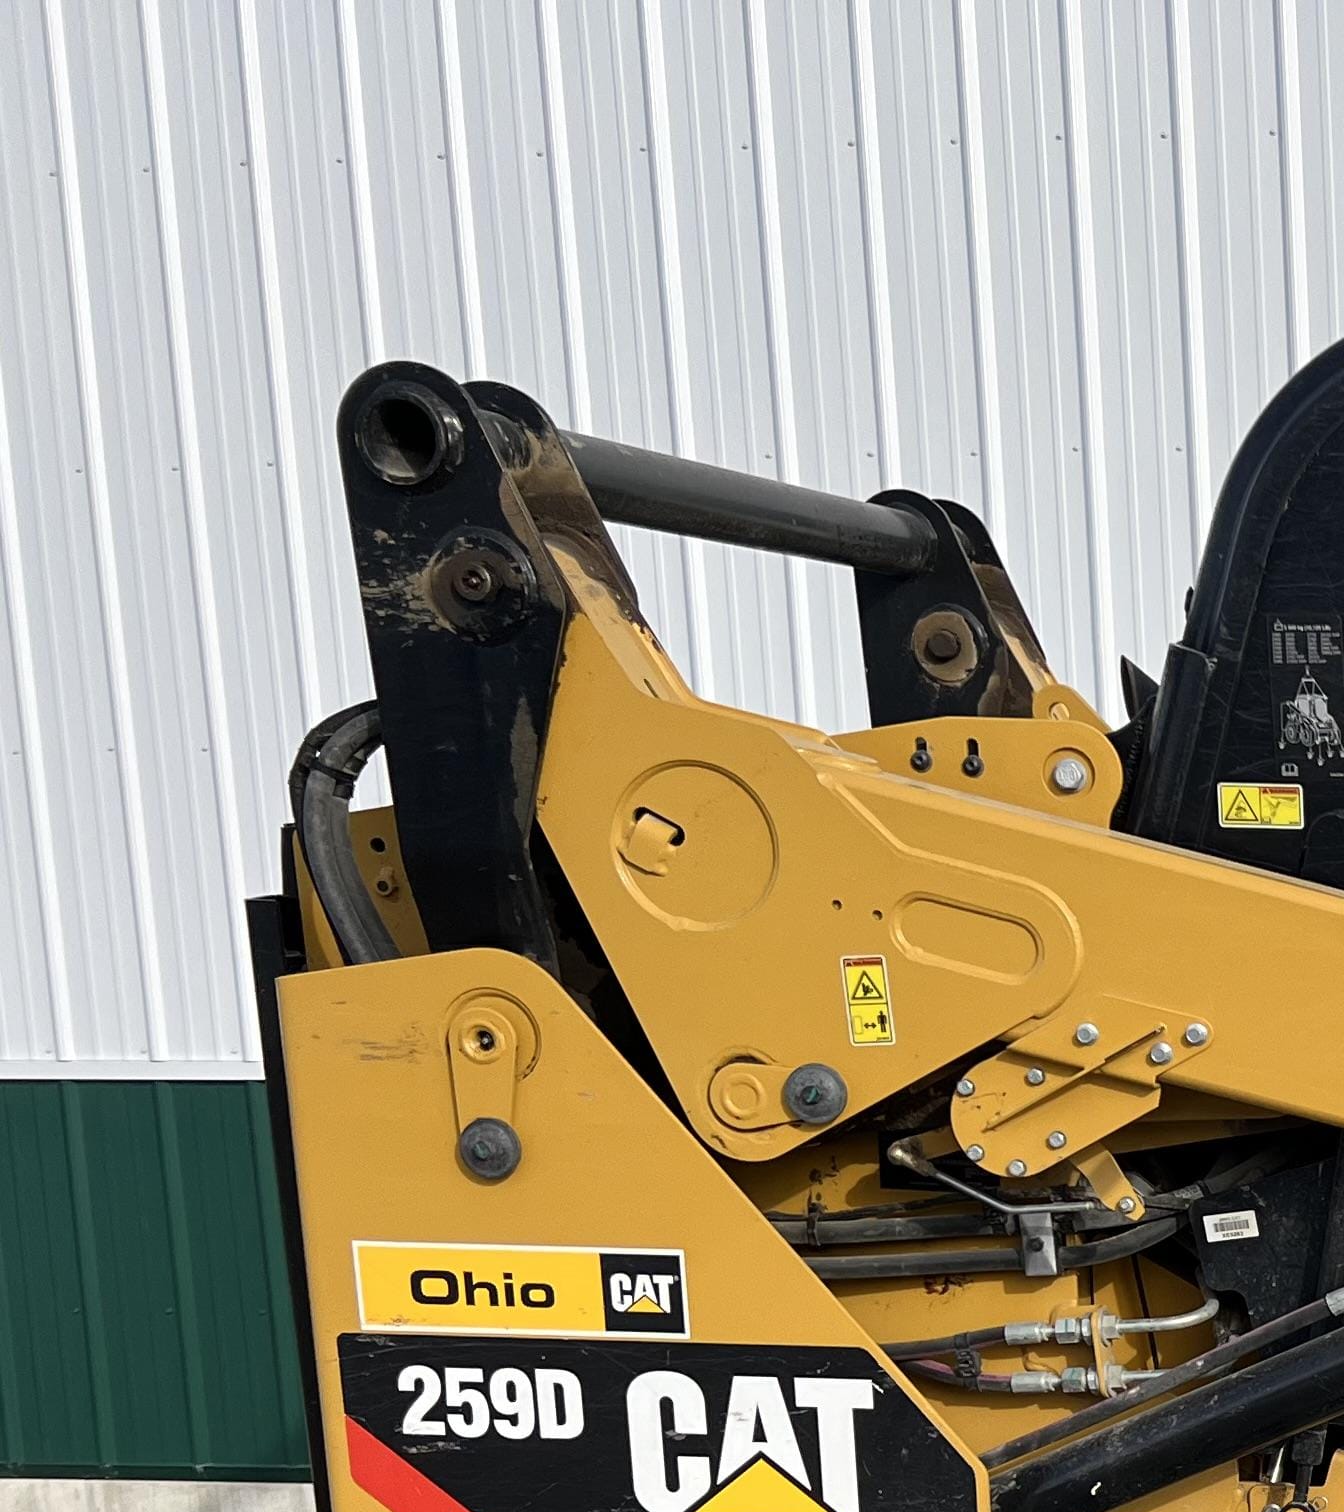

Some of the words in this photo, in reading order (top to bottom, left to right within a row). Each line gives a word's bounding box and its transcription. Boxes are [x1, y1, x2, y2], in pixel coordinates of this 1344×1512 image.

[411, 1270, 556, 1309] Ohio
[610, 1273, 677, 1313] CAT
[397, 1365, 585, 1441] 259D
